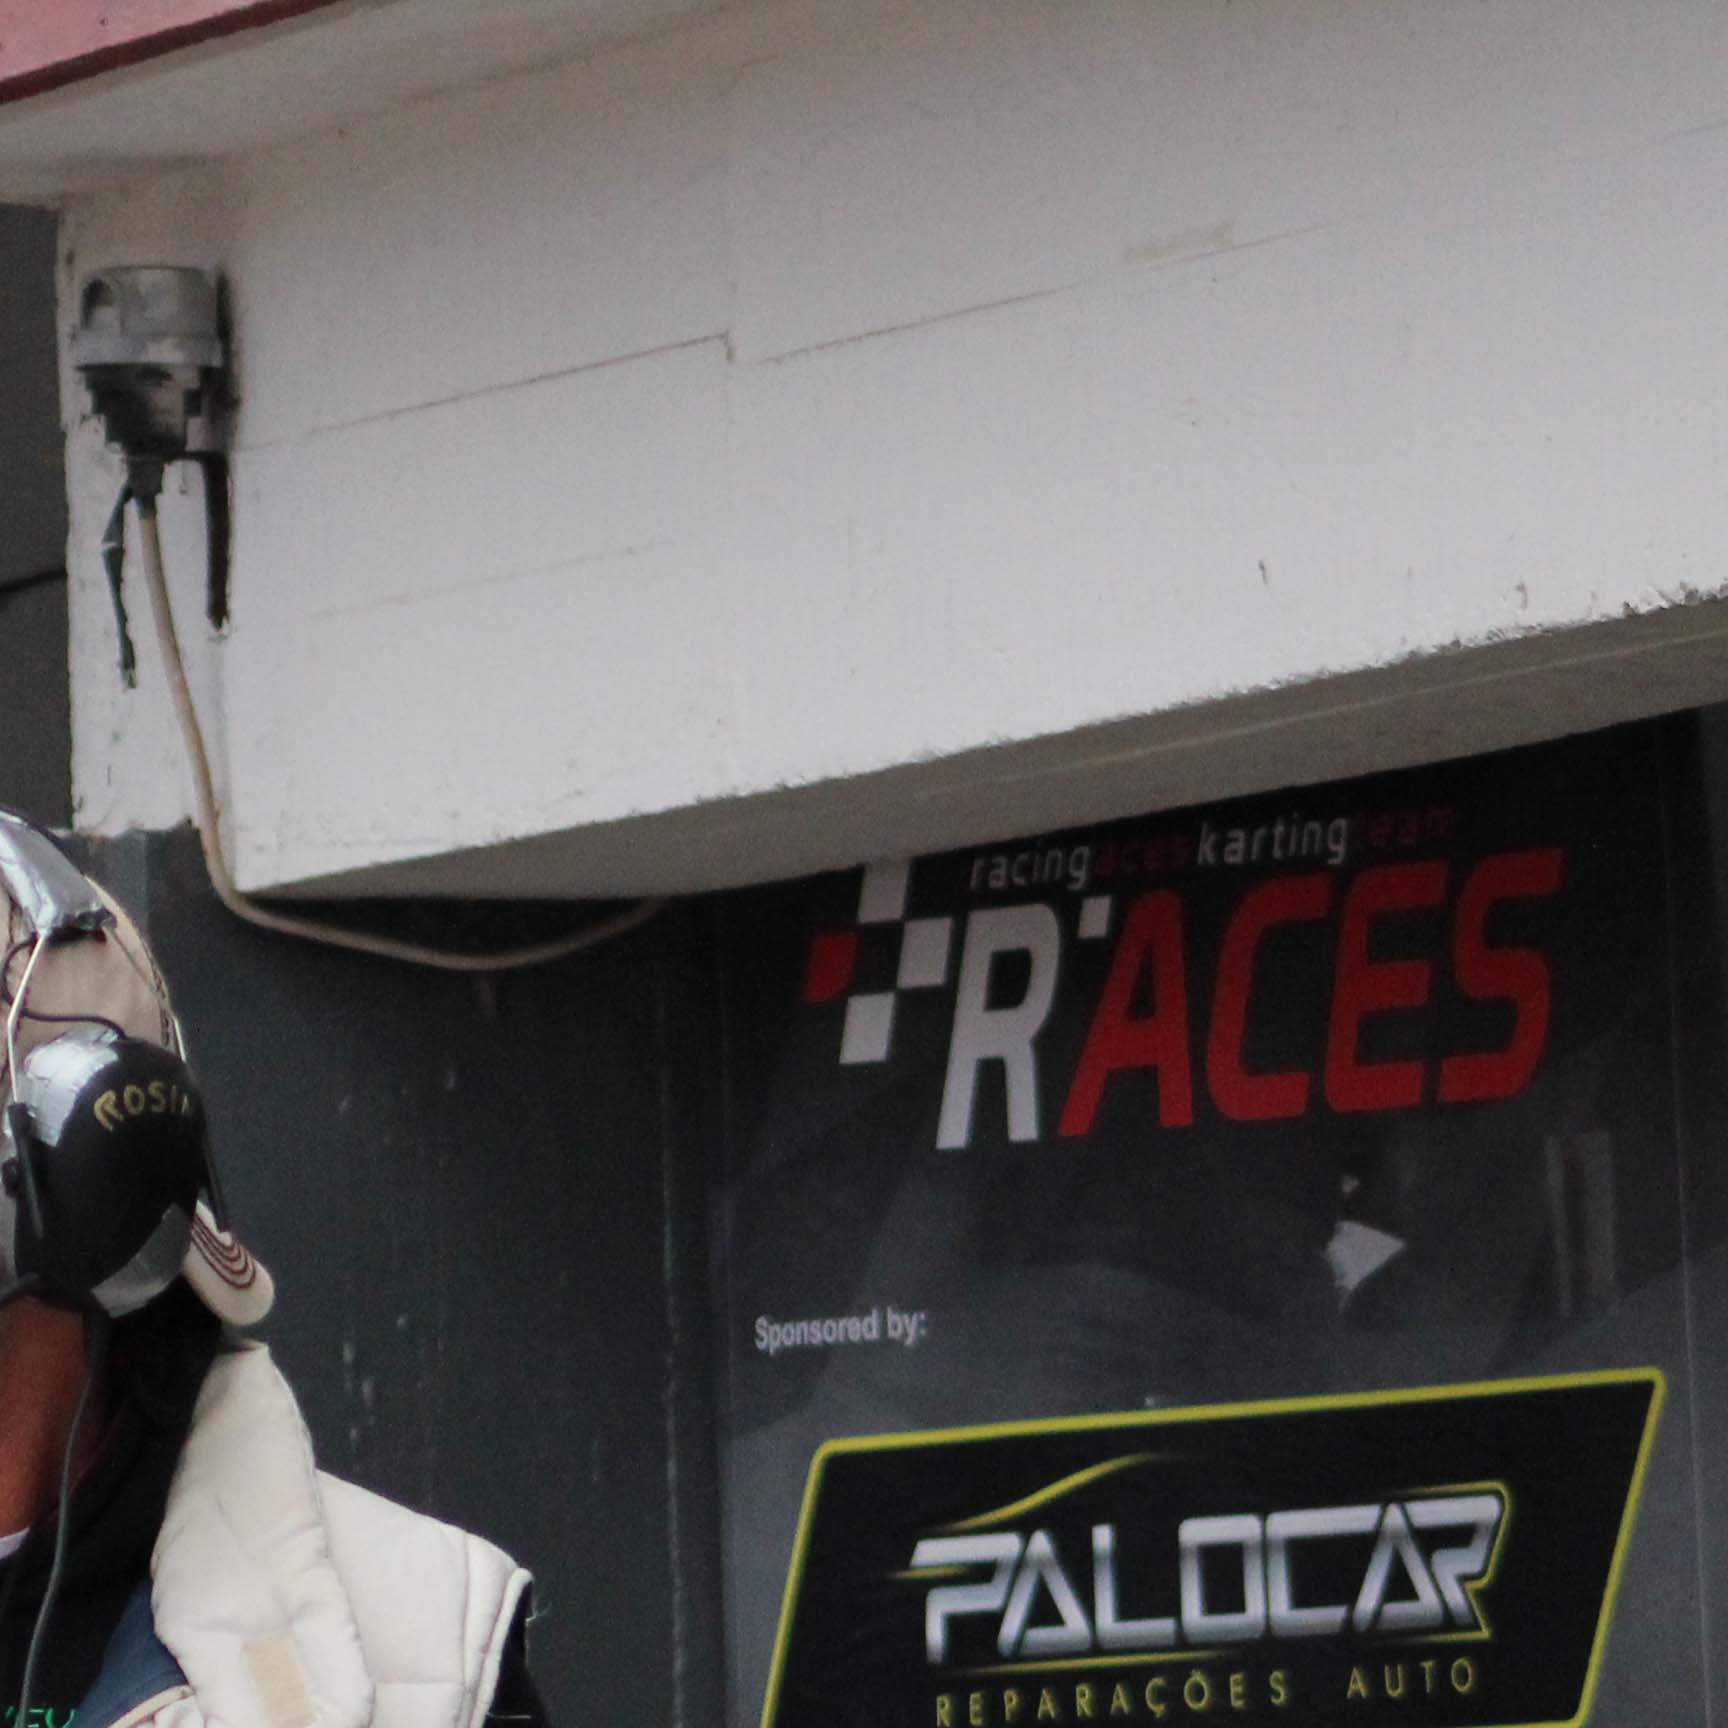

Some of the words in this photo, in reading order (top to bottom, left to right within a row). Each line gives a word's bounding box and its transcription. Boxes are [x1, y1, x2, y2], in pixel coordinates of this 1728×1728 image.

[754, 1310, 882, 1355] Sponsored
[886, 1308, 929, 1350] by:
[910, 1494, 1502, 1664] PALOCAR
[1347, 1657, 1477, 1700] AUTO
